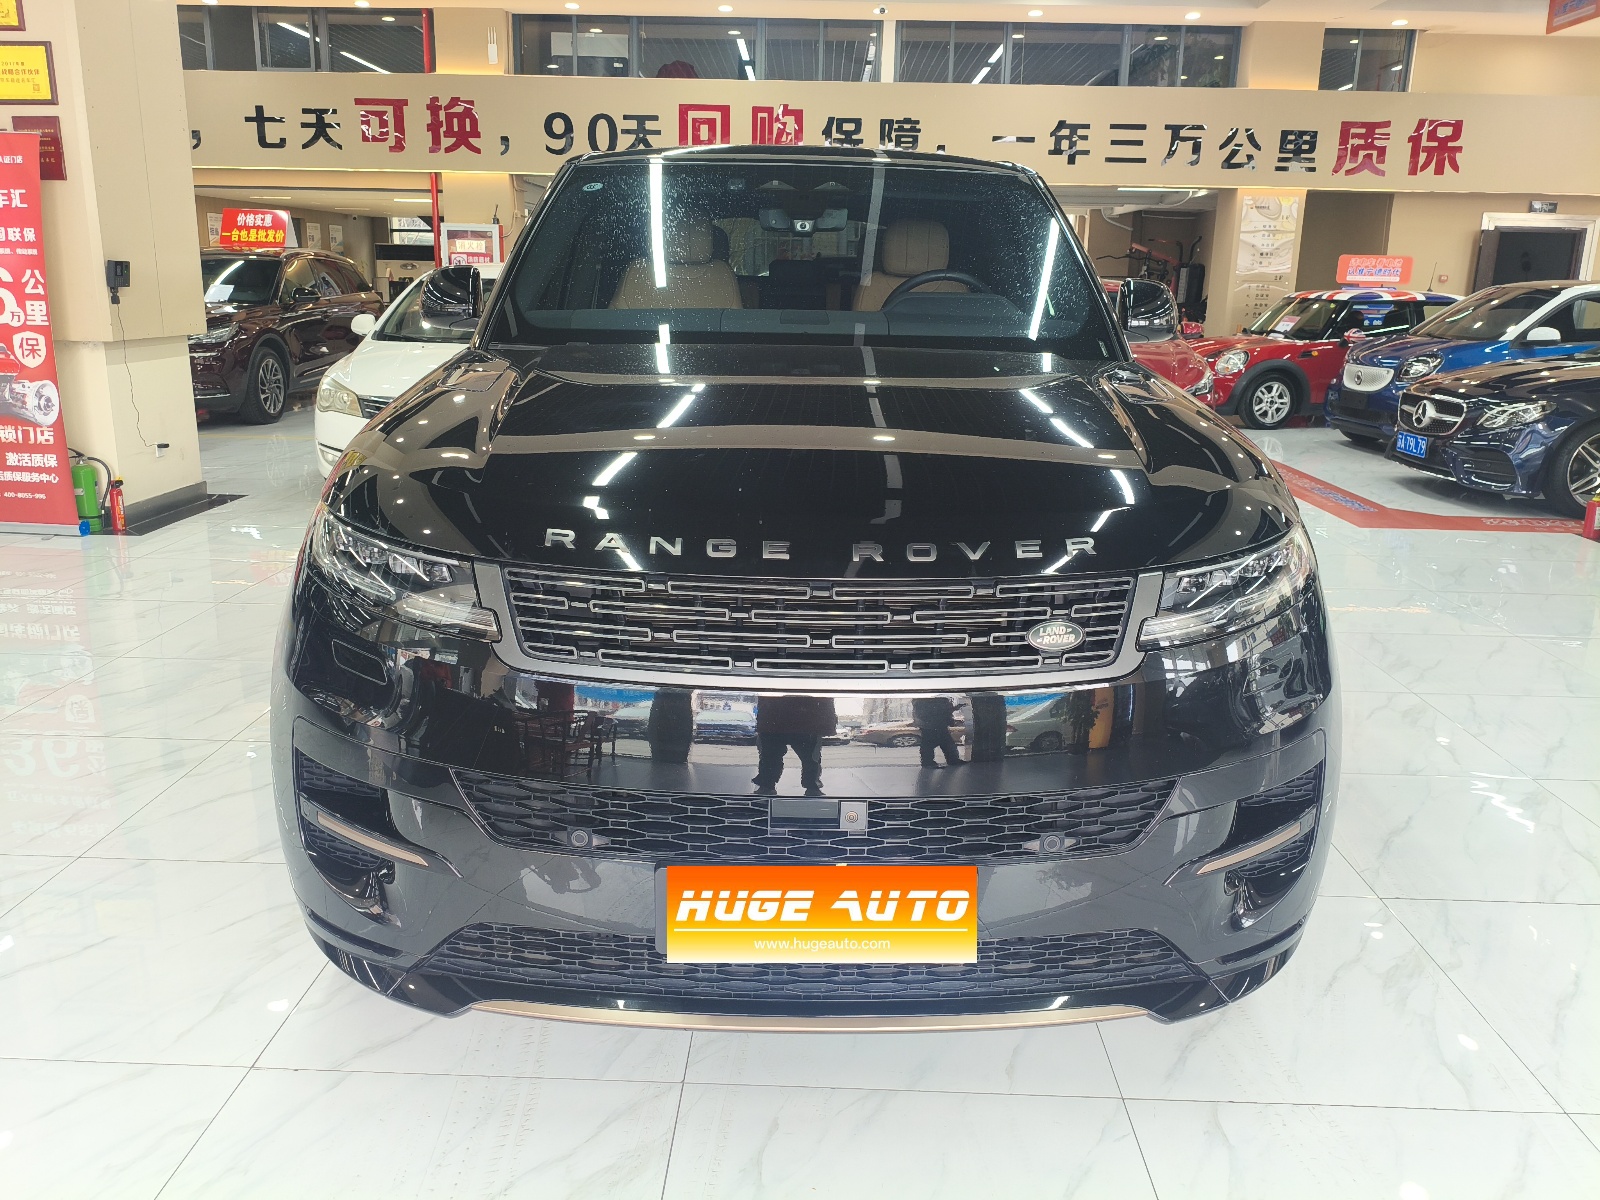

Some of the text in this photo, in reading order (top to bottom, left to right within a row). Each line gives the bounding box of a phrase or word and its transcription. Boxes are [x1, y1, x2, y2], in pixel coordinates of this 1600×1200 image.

[236, 212, 274, 227] 价格实惠
[221, 228, 285, 242] 一台也是批发价
[19, 337, 42, 360] 保
[5, 452, 58, 468] 激活质保
[544, 527, 1098, 562] RANGE ROVER
[1039, 626, 1067, 636] LAND
[1042, 633, 1076, 645] ROVER
